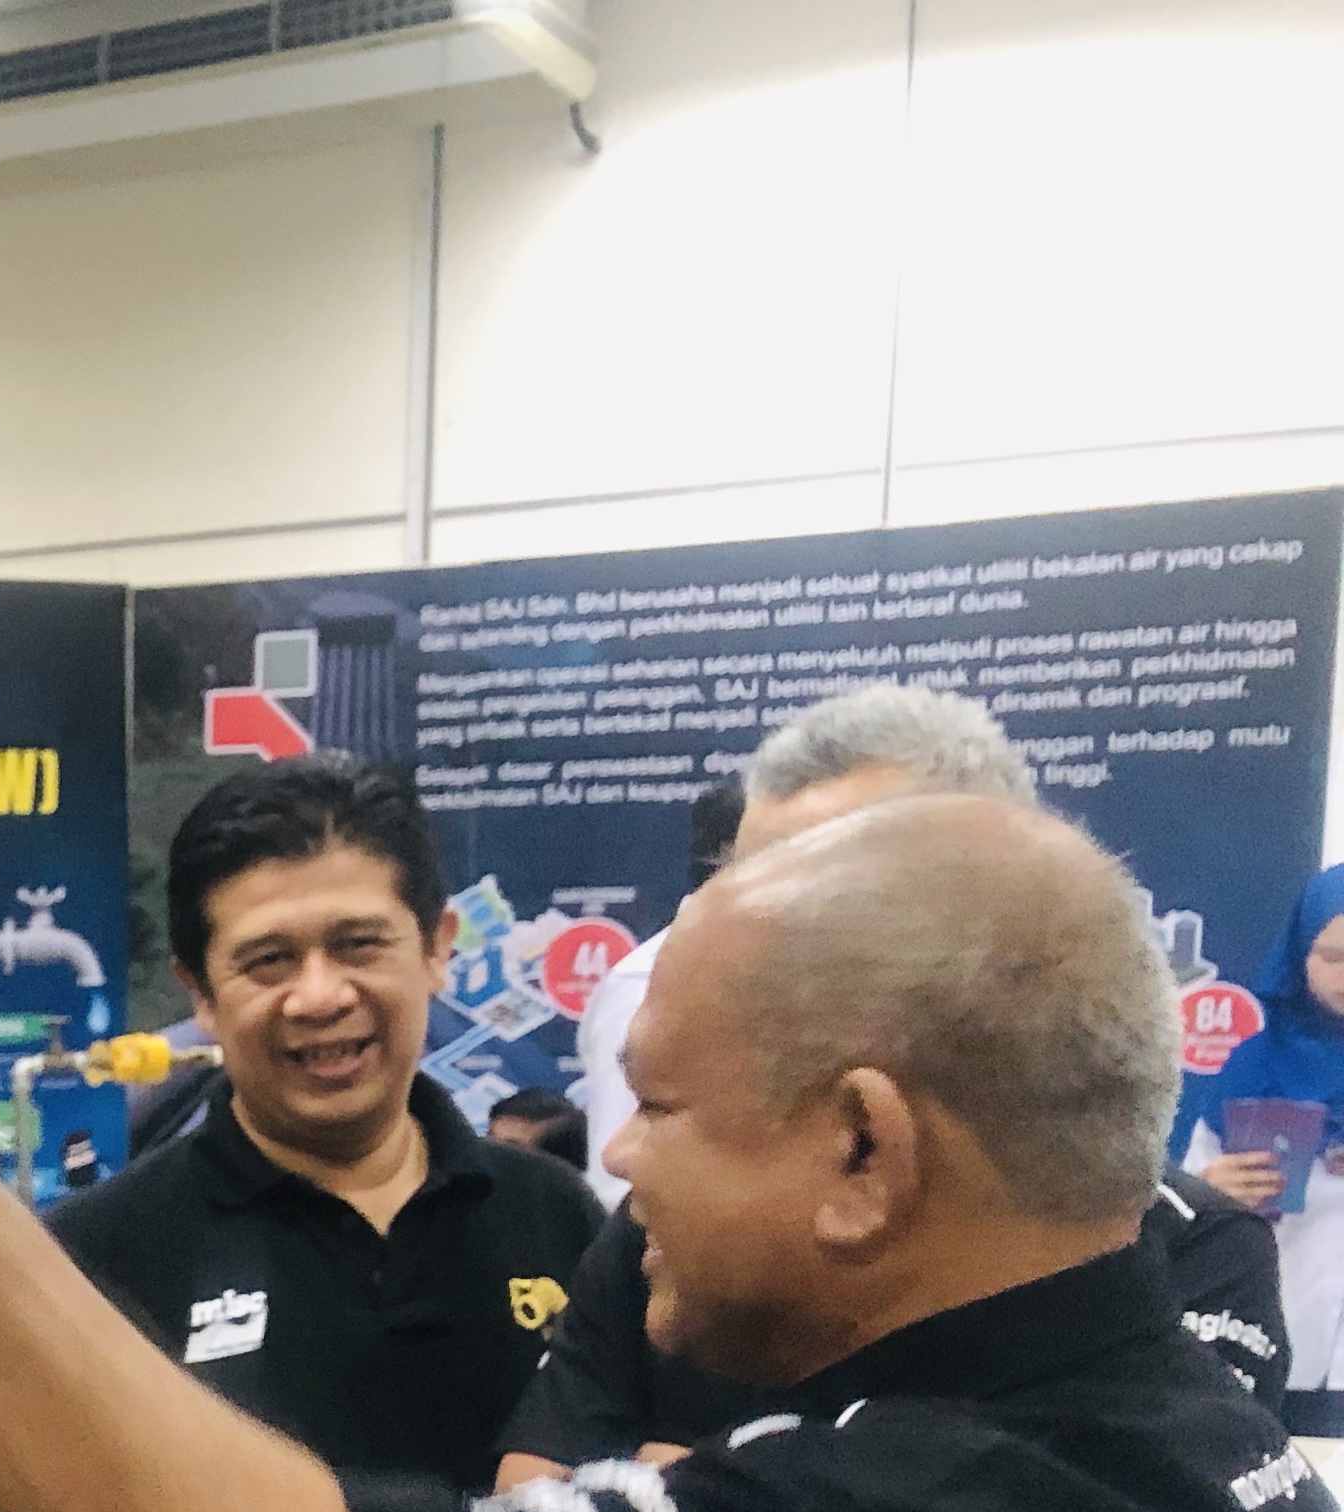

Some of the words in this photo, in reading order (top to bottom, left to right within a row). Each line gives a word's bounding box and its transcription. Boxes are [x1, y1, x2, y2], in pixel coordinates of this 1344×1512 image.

[1032, 550, 1125, 579] bekalan
[1128, 548, 1161, 571] air
[1164, 543, 1224, 574] yang
[1227, 537, 1304, 565] cekap
[1078, 626, 1173, 653] rawatan
[1178, 620, 1211, 645] air
[1213, 617, 1298, 648] hingga
[977, 657, 1122, 687] memberikan
[1130, 645, 1296, 678] perkhidmatan
[1087, 684, 1134, 708] dan
[1106, 725, 1215, 755] terhadap
[1227, 722, 1292, 749] mutu
